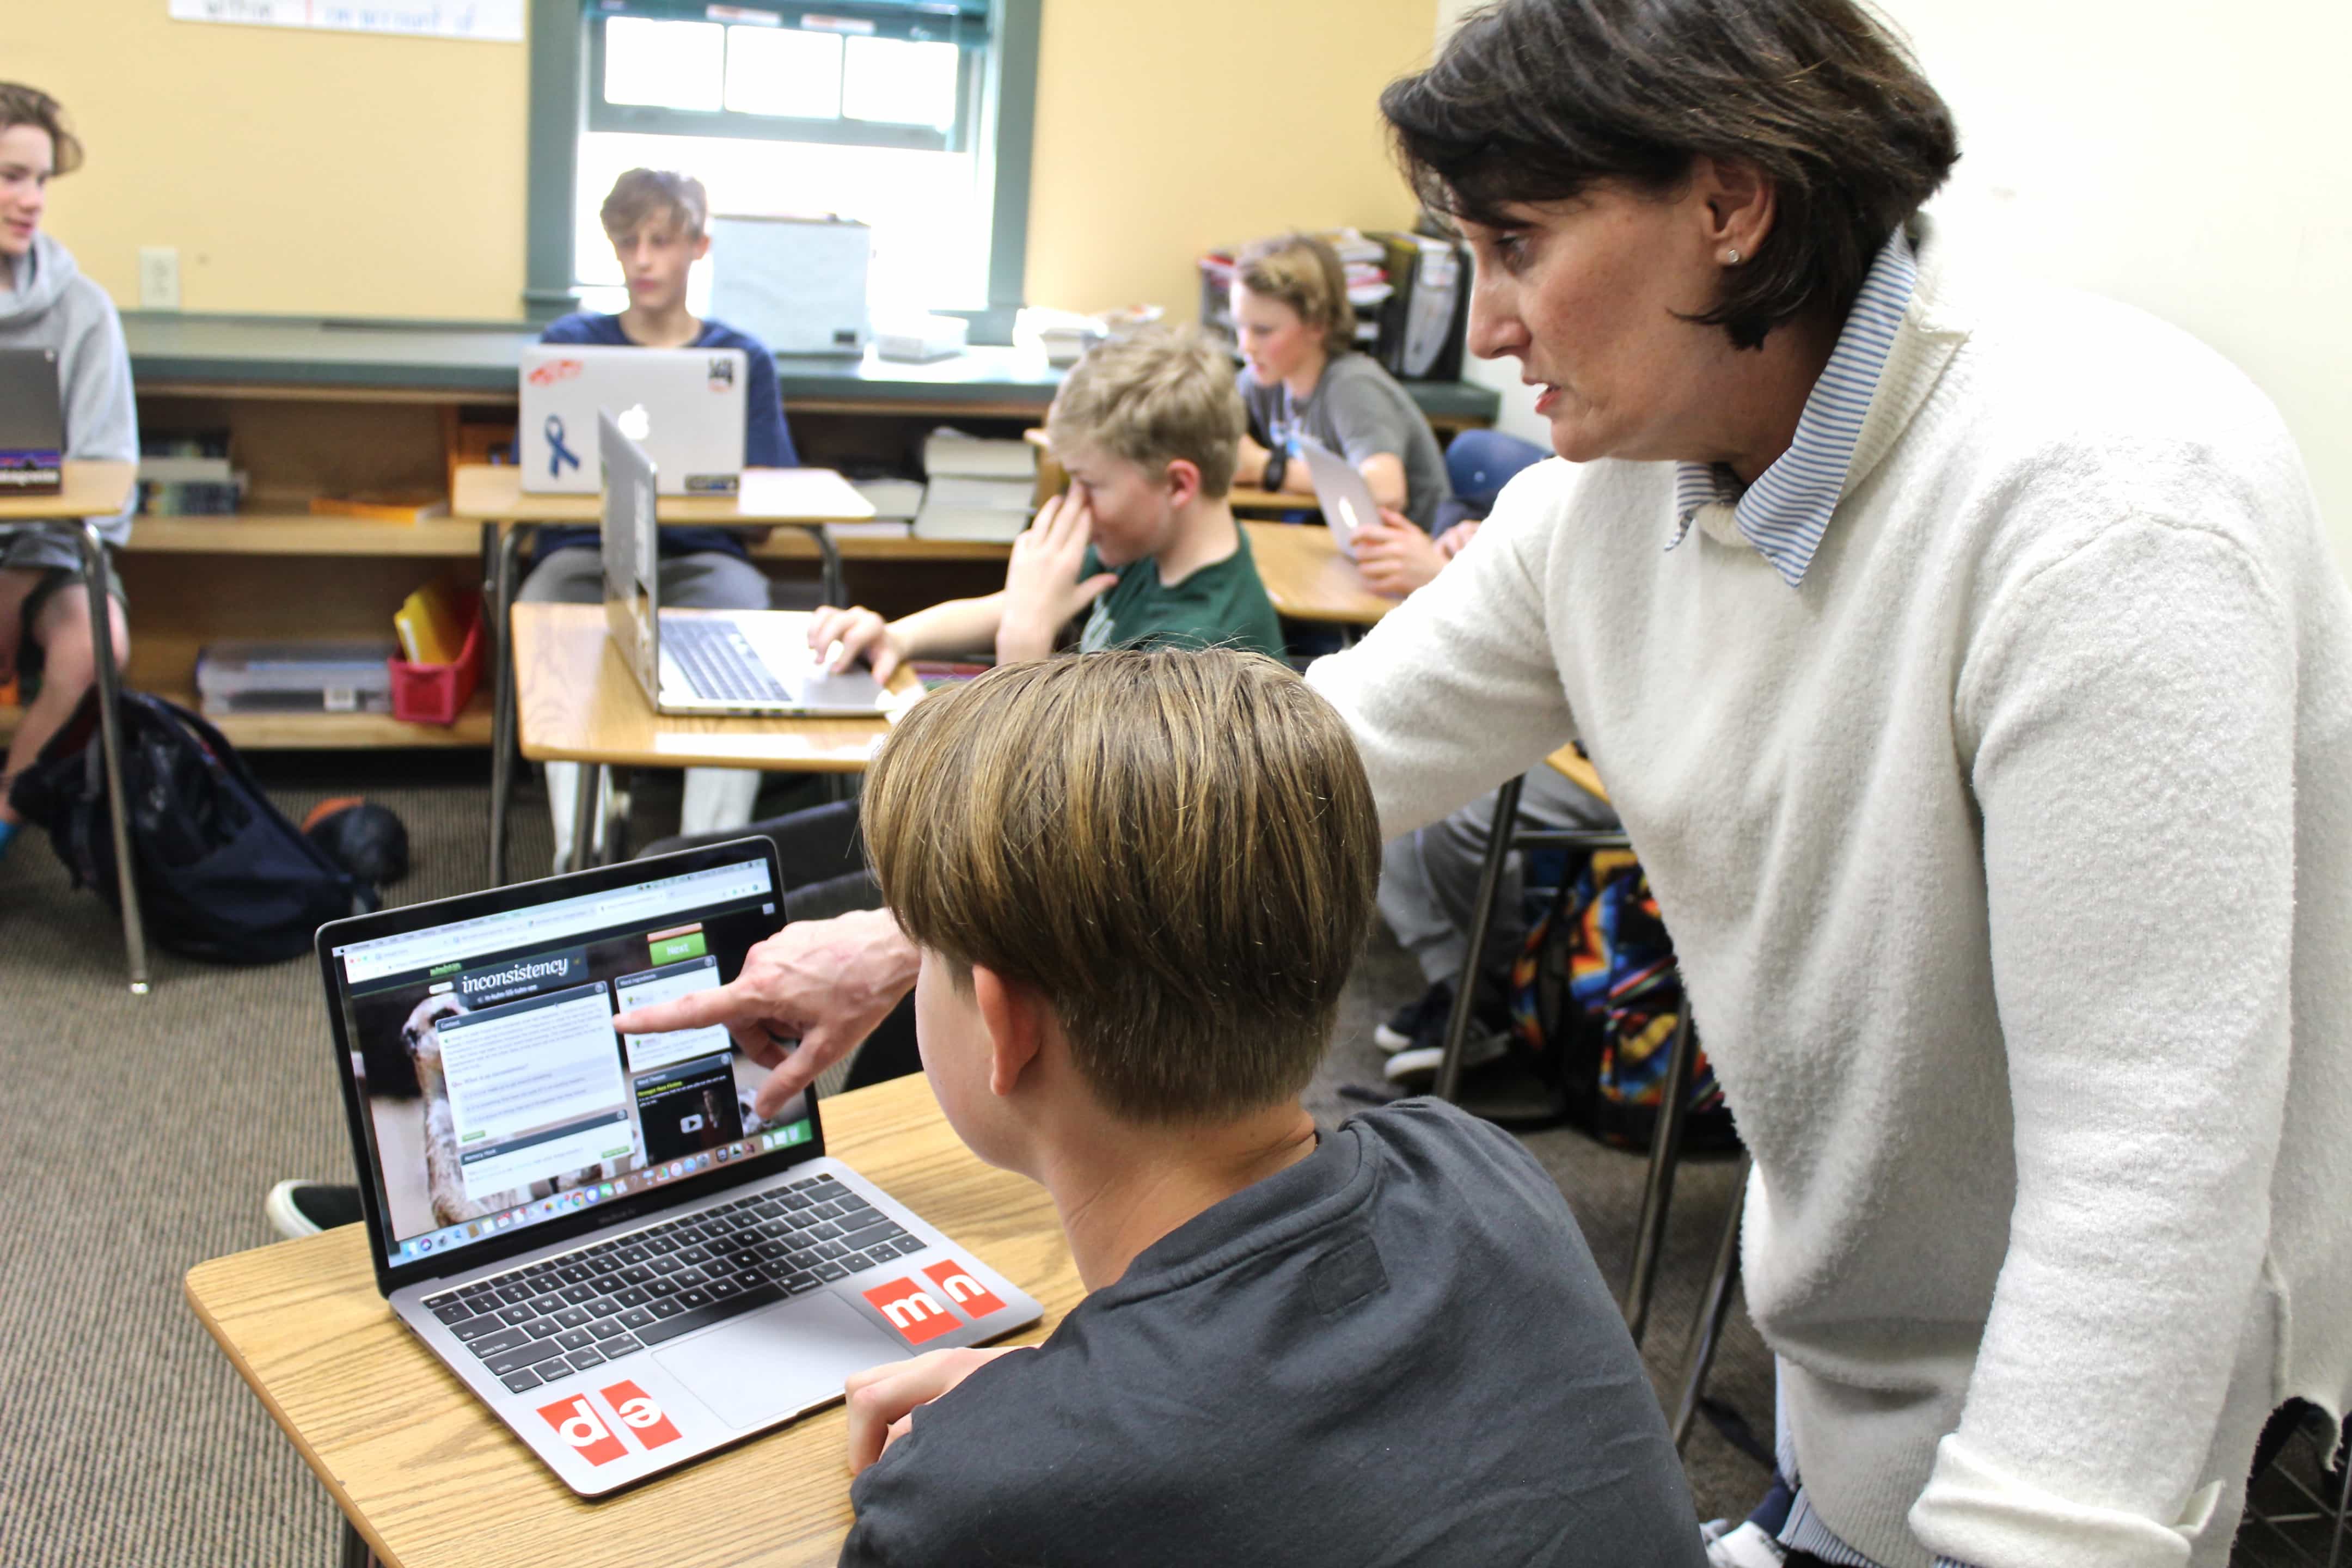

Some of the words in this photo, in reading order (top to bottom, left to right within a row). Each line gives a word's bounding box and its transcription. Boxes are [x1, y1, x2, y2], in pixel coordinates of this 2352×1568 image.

[666, 942, 690, 956] Next
[462, 958, 568, 994] inconsistency
[881, 1292, 945, 1328] m
[559, 1398, 610, 1447] d
